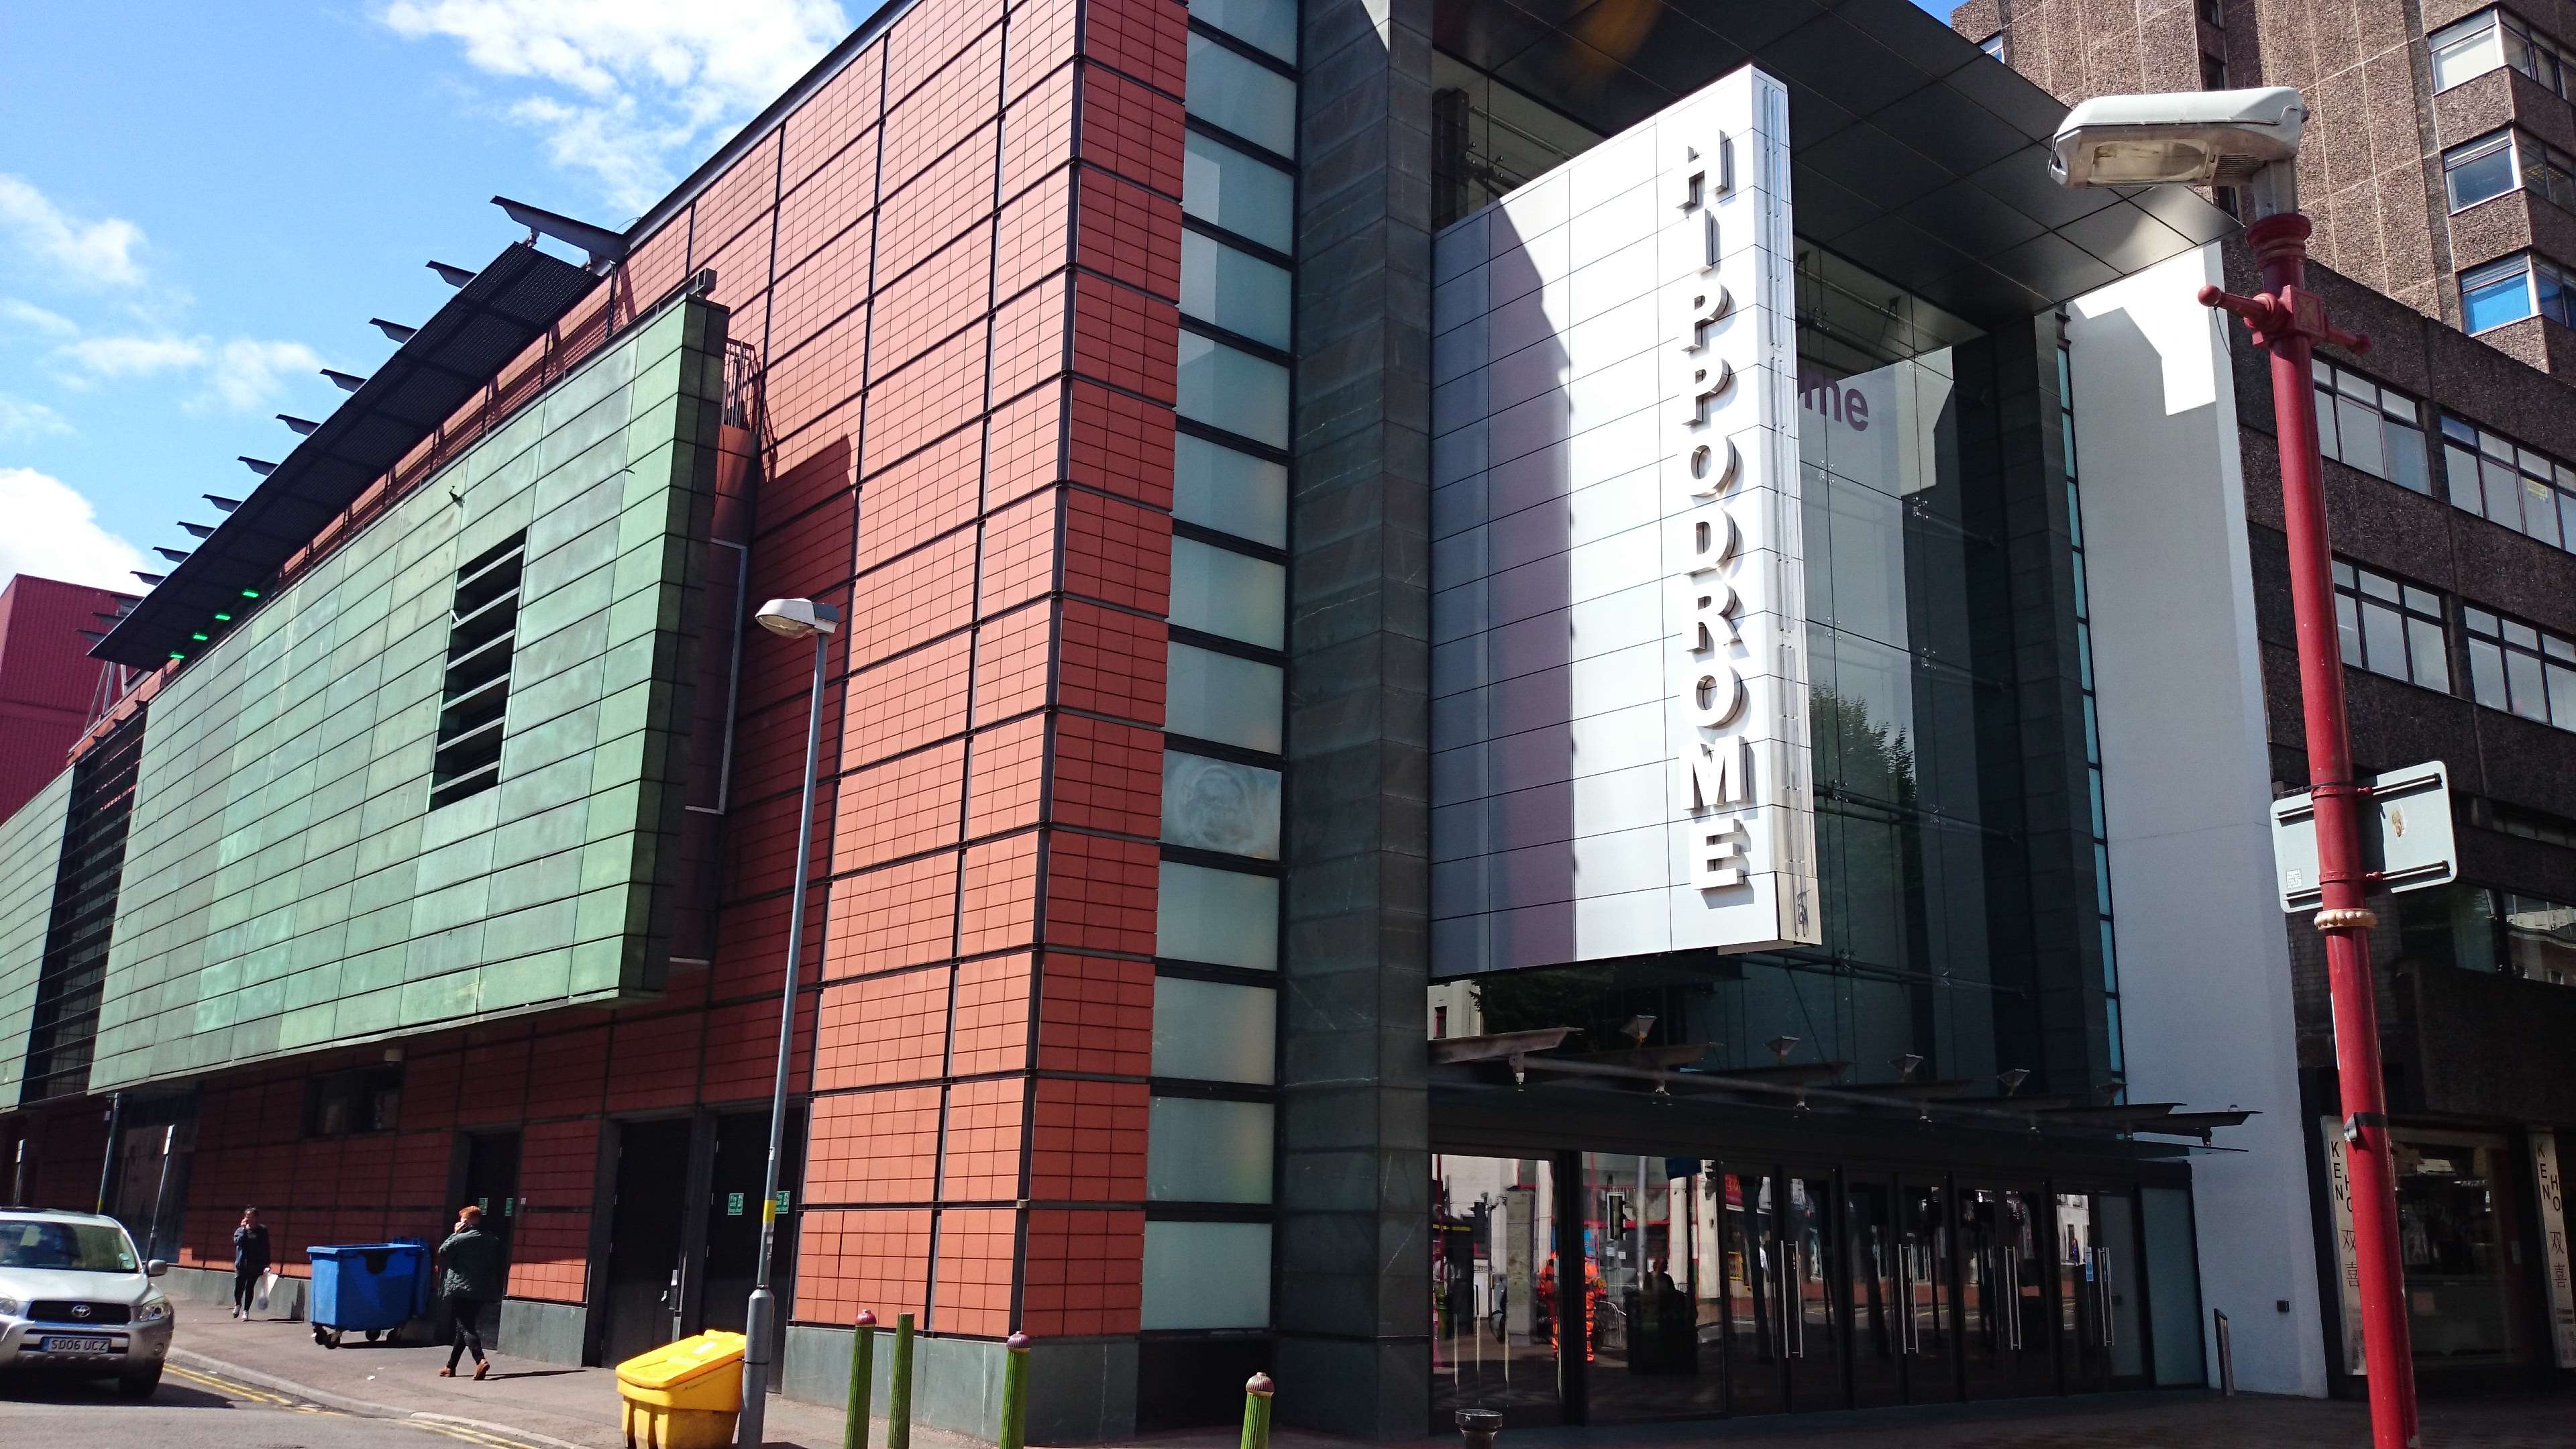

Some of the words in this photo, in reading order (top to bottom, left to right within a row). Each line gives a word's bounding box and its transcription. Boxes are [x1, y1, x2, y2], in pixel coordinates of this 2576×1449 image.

[1798, 370, 1868, 432] me
[1677, 129, 1750, 891] HIPPODROME
[2330, 1141, 2343, 1200] KEN
[2537, 1142, 2551, 1200] KEN
[2551, 1175, 2561, 1212] HO
[2550, 1232, 2567, 1288] 双喜
[51, 1340, 80, 1350] SD06
[84, 1340, 108, 1351] UCZ
